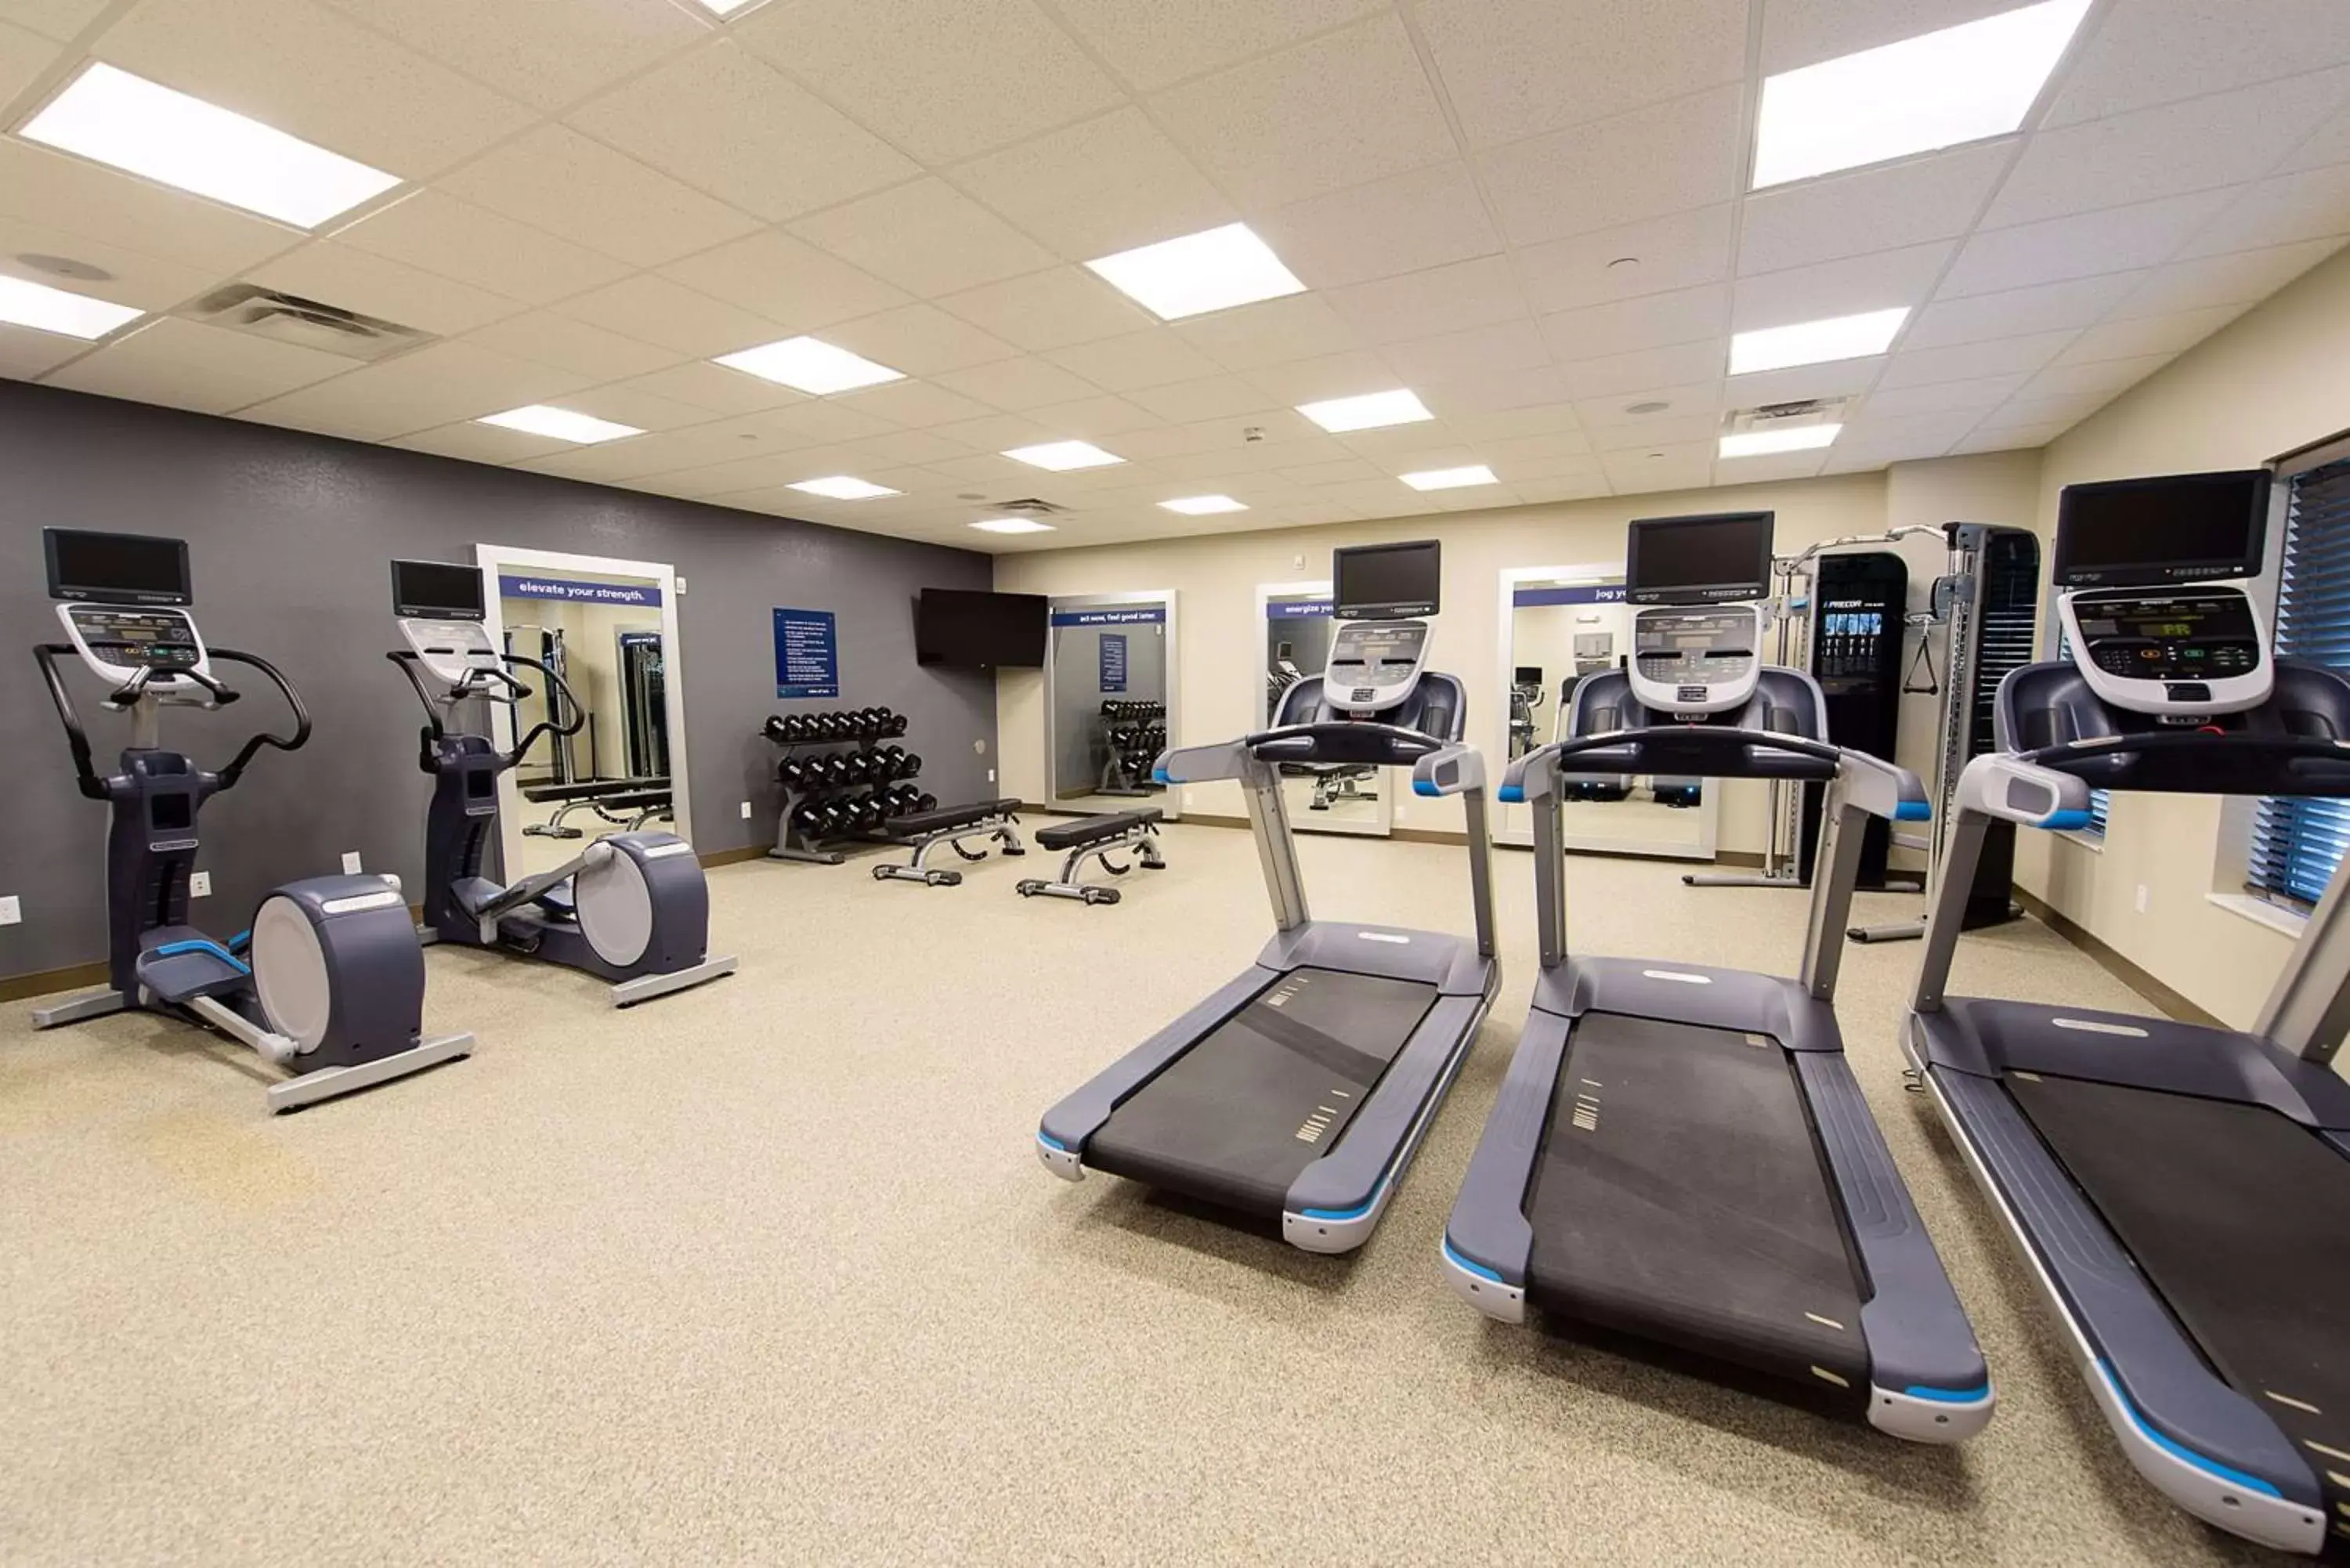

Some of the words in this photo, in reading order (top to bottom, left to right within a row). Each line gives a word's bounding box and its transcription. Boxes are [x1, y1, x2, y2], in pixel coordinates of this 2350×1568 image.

[519, 581, 565, 594] elevate
[567, 587, 594, 598] your
[596, 589, 645, 602] strength.
[1595, 589, 1614, 600] jog
